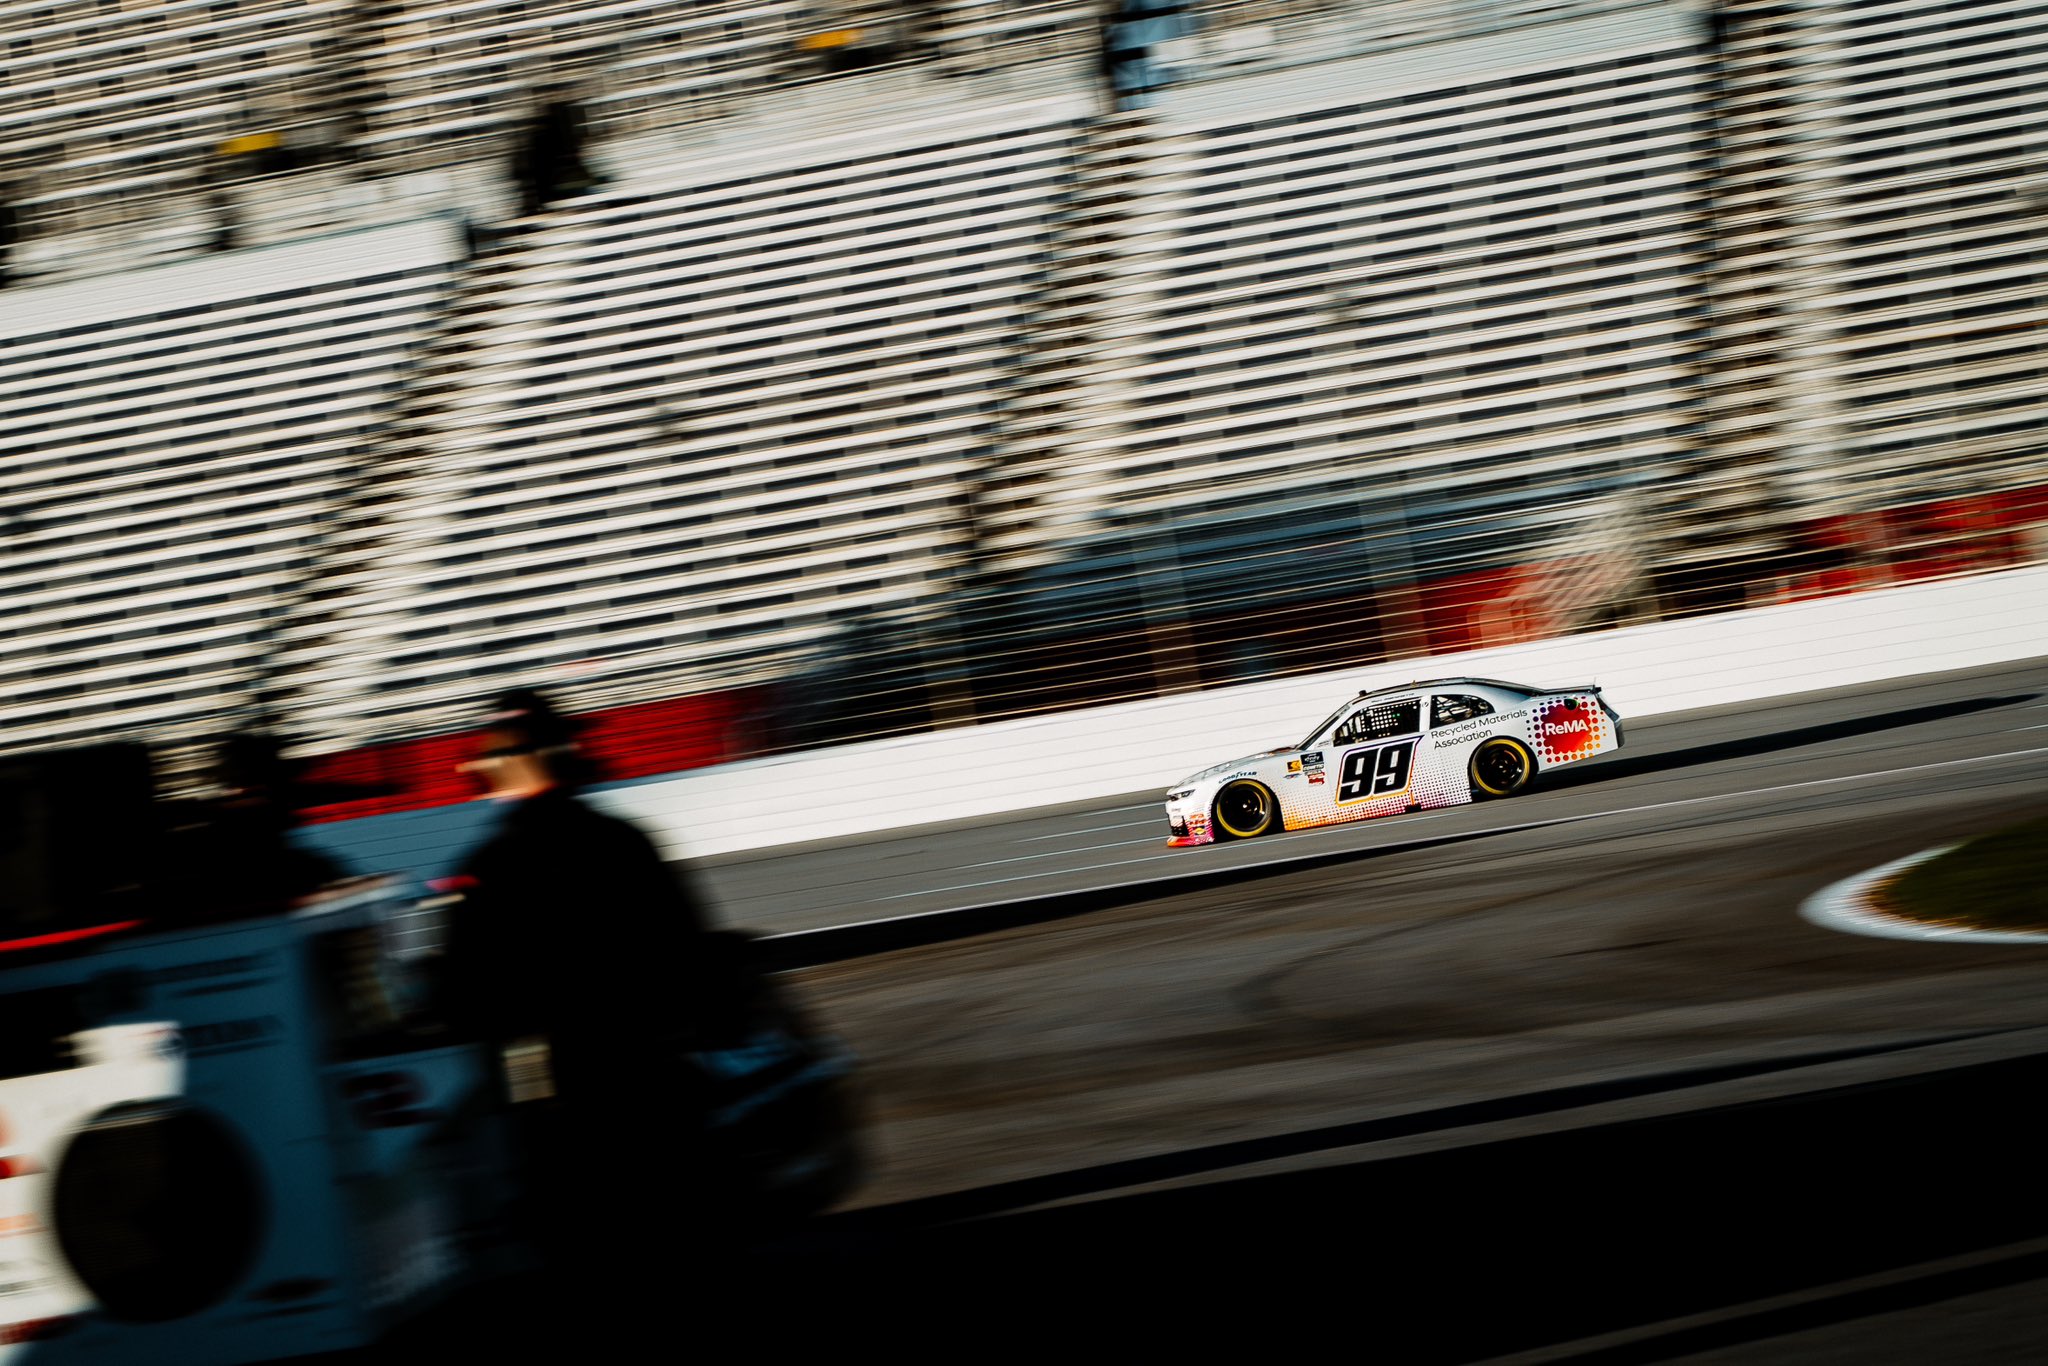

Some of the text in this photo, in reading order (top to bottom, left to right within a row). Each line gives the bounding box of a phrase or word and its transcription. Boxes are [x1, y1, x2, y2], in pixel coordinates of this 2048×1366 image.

[1430, 709, 1528, 739] Recycled Materials
[1545, 719, 1589, 736] ReMA
[1434, 729, 1492, 750] Association
[1218, 771, 1258, 784] GOODYEAR
[1339, 741, 1415, 802] 99
